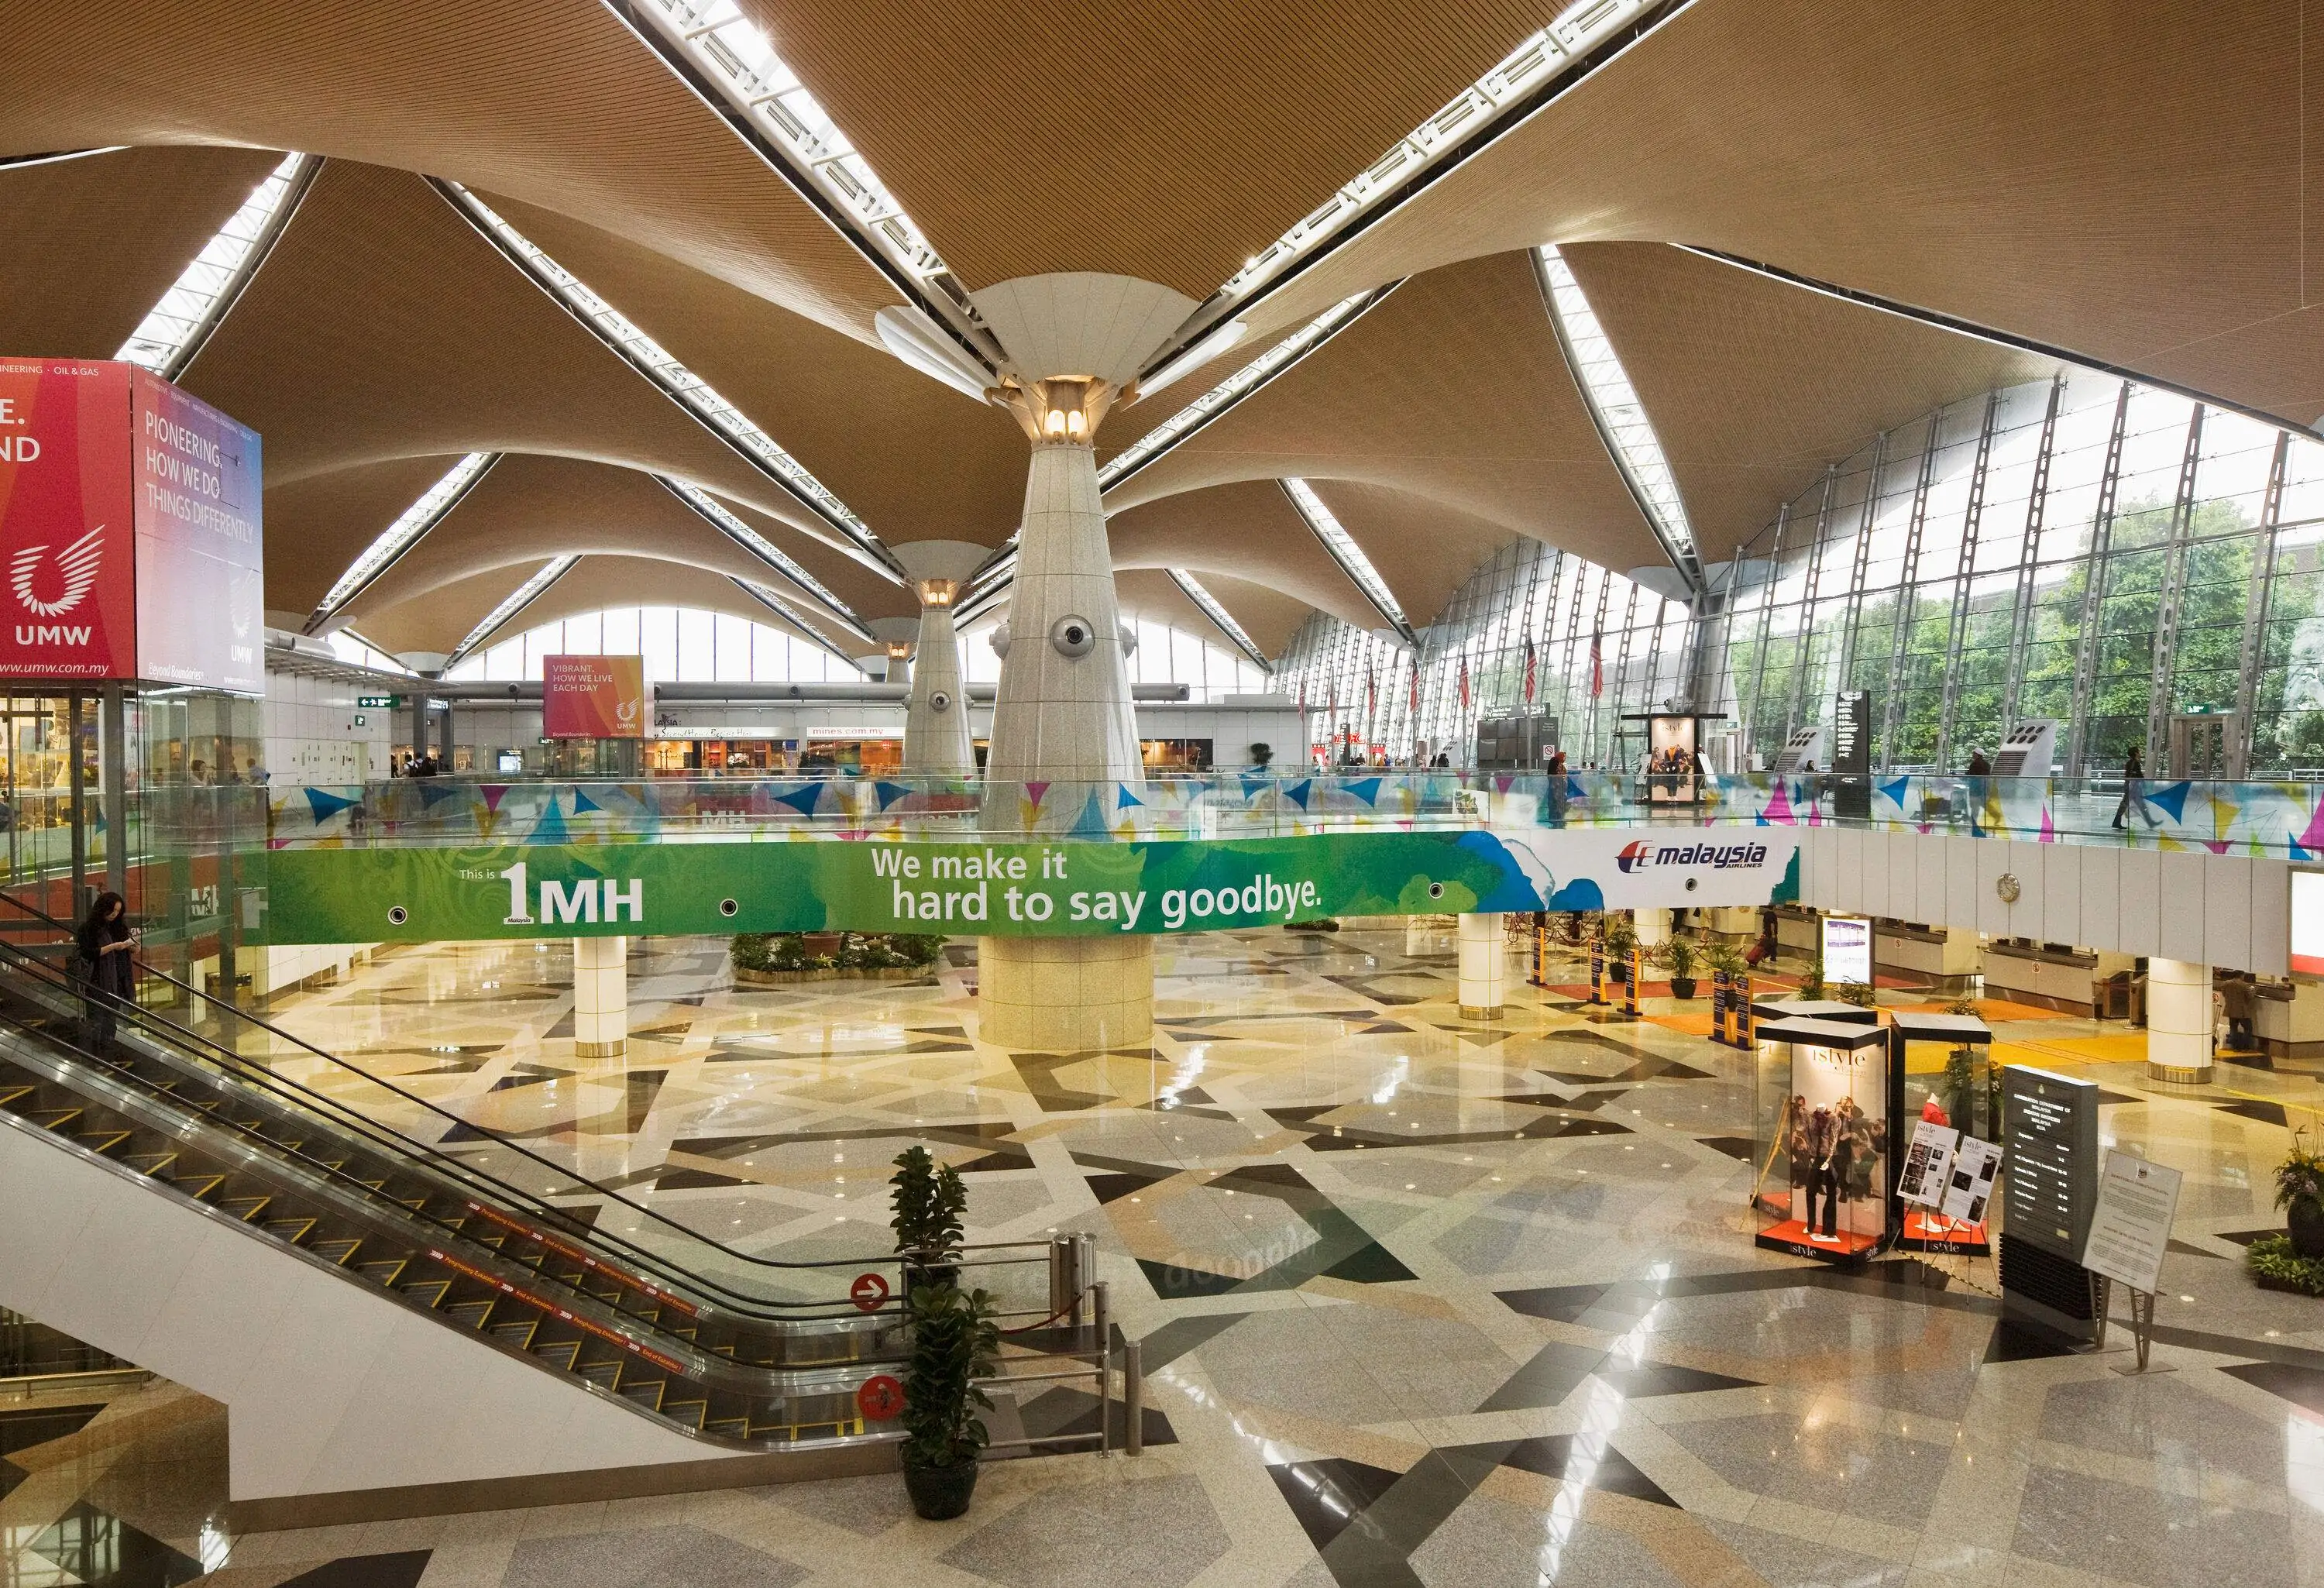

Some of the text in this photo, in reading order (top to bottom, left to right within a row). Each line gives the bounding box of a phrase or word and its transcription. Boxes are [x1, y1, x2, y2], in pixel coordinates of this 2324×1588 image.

[53, 366, 70, 375] OIL
[71, 367, 78, 376] &
[80, 367, 99, 376] GAS
[146, 446, 221, 500] HOW WE DO
[146, 482, 253, 543] THINGS DIFFERENTLY
[15, 625, 91, 646] UMW
[231, 644, 253, 665] UMW
[149, 662, 170, 679] Beyond
[552, 674, 613, 682] HOW WE LIVE
[871, 848, 1067, 879] We make it
[1655, 842, 1768, 868] malaysia
[459, 869, 483, 879] This
[486, 869, 495, 879] is
[893, 874, 1321, 930] hard to say goodbye.
[1813, 1048, 1865, 1069] istyle
[1917, 1124, 1937, 1135] istyle
[516, 1290, 526, 1299] End
